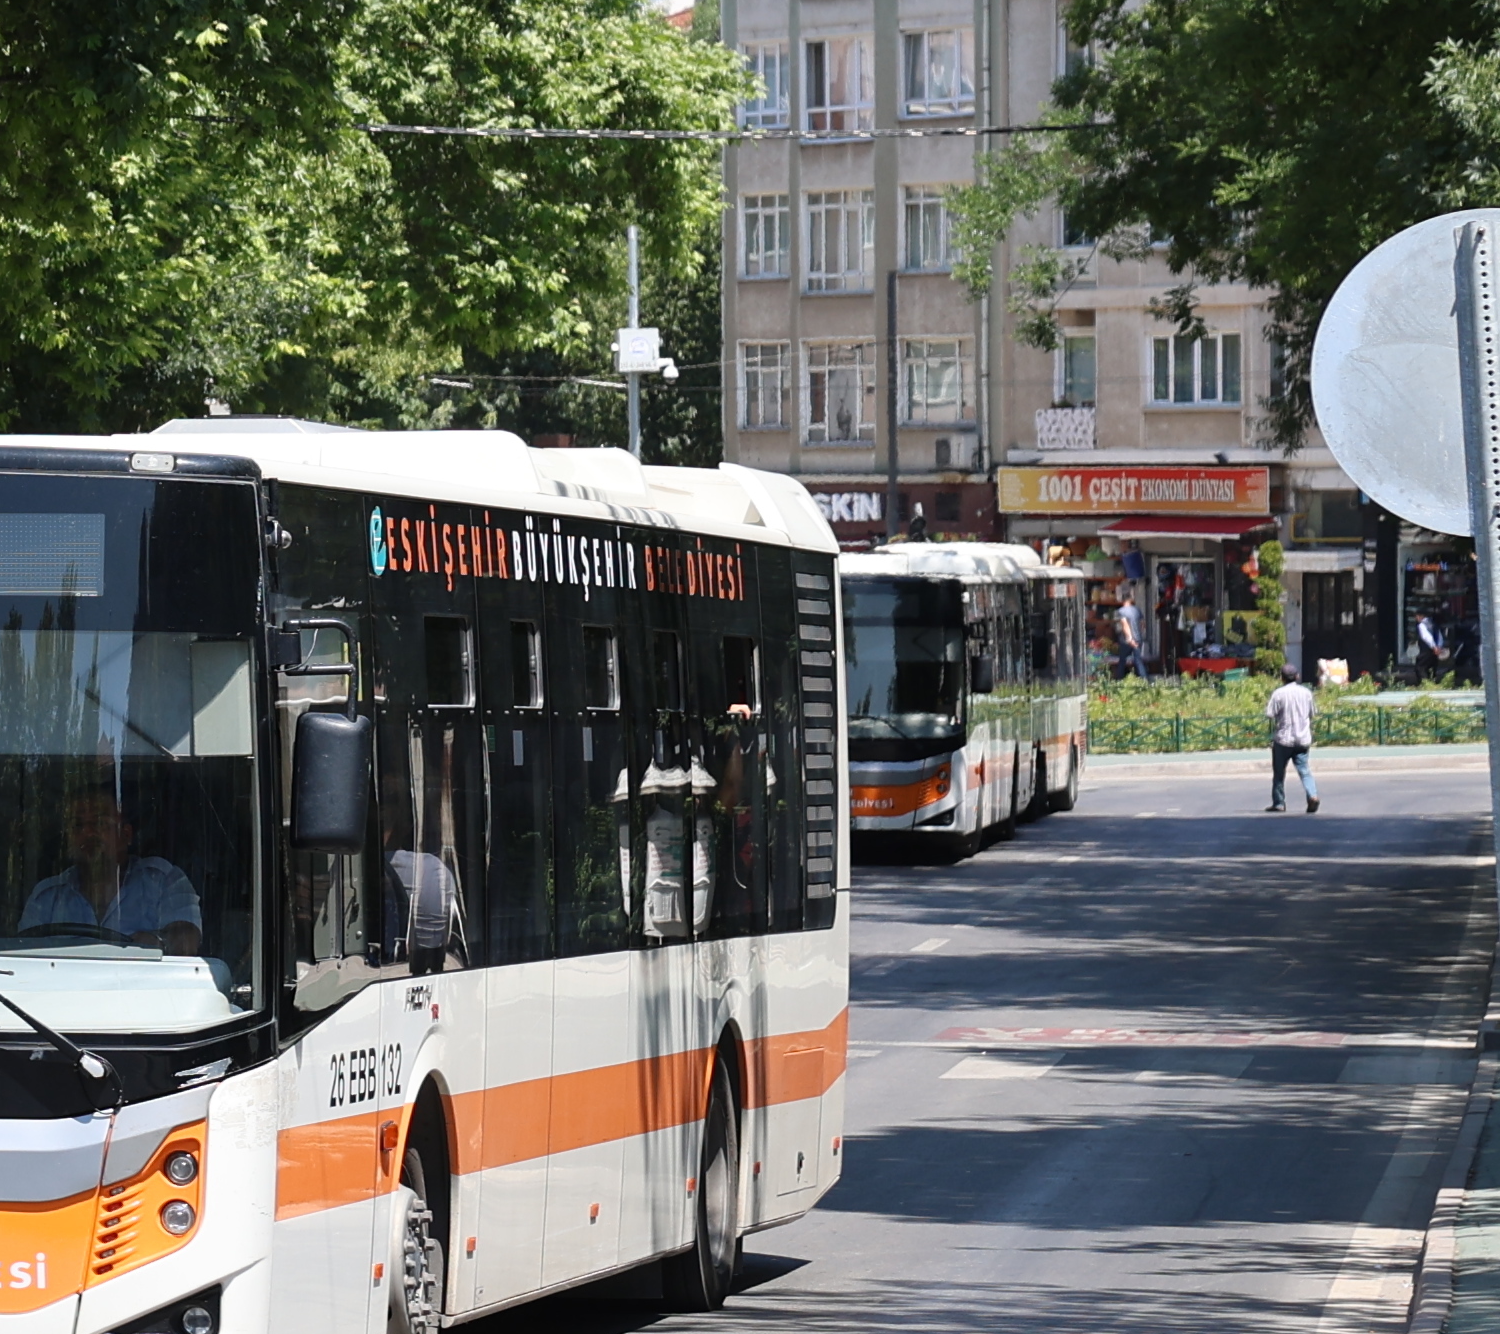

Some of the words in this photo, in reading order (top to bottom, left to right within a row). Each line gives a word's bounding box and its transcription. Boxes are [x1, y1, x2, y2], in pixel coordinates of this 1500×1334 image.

[1038, 474, 1082, 503] 1001
[1089, 471, 1139, 508] ÇEŞİT
[1141, 472, 1190, 501] EKONOMİ
[1192, 472, 1235, 502] DÜNYASI
[386, 504, 508, 592] ESKİŞEHİR
[512, 515, 637, 602] BÜYÜKŞEHİR
[644, 536, 745, 601] BELEDİYESİ
[329, 1052, 346, 1108] 26
[348, 1047, 377, 1105] EBB
[381, 1042, 402, 1097] 132
